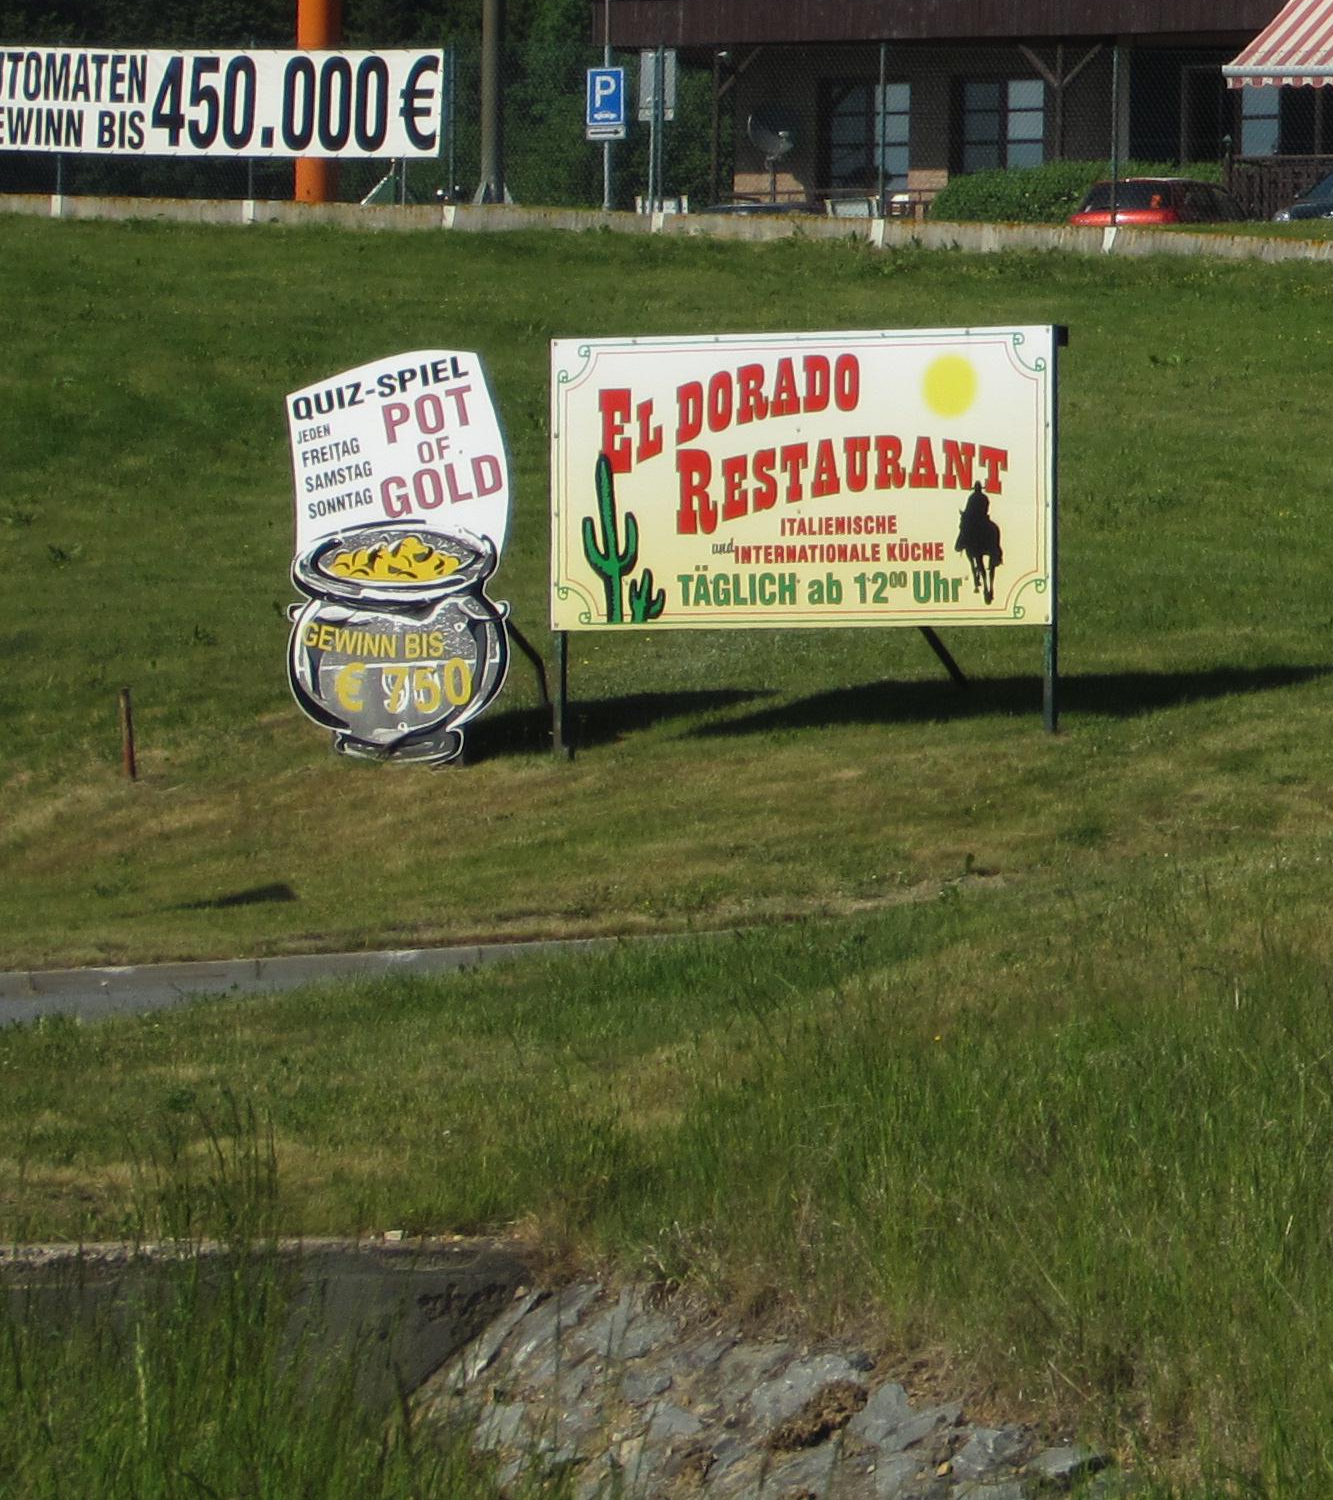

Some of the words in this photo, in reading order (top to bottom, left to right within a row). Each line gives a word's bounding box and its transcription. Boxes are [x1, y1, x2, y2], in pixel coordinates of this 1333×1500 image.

[152, 56, 389, 152] 450.000
[399, 55, 440, 151] €
[595, 75, 616, 107] P
[101, 111, 145, 149] BIS
[292, 356, 469, 421] QUIZ-SPIEL
[381, 385, 472, 444] POT
[599, 387, 663, 473] EL
[675, 353, 860, 446] DORADO
[297, 423, 331, 444] JEDEN
[416, 436, 450, 464] OF
[301, 437, 361, 468] FREITAG
[305, 461, 373, 493] SAMSTAG
[379, 454, 503, 518] GOLD
[675, 434, 1008, 535] RESTAURANT
[308, 488, 373, 519] SONNTAG
[780, 515, 898, 536] ITALIENISCHE
[711, 537, 734, 556] und
[734, 543, 881, 564] INTERNATIONALE
[886, 538, 945, 562] KÜCHE
[676, 565, 797, 607] TÄGLICH
[807, 572, 844, 605] ab
[912, 570, 963, 604] Uhr
[303, 622, 396, 658] GEWINN
[404, 631, 444, 659] BIS
[335, 661, 367, 712] €
